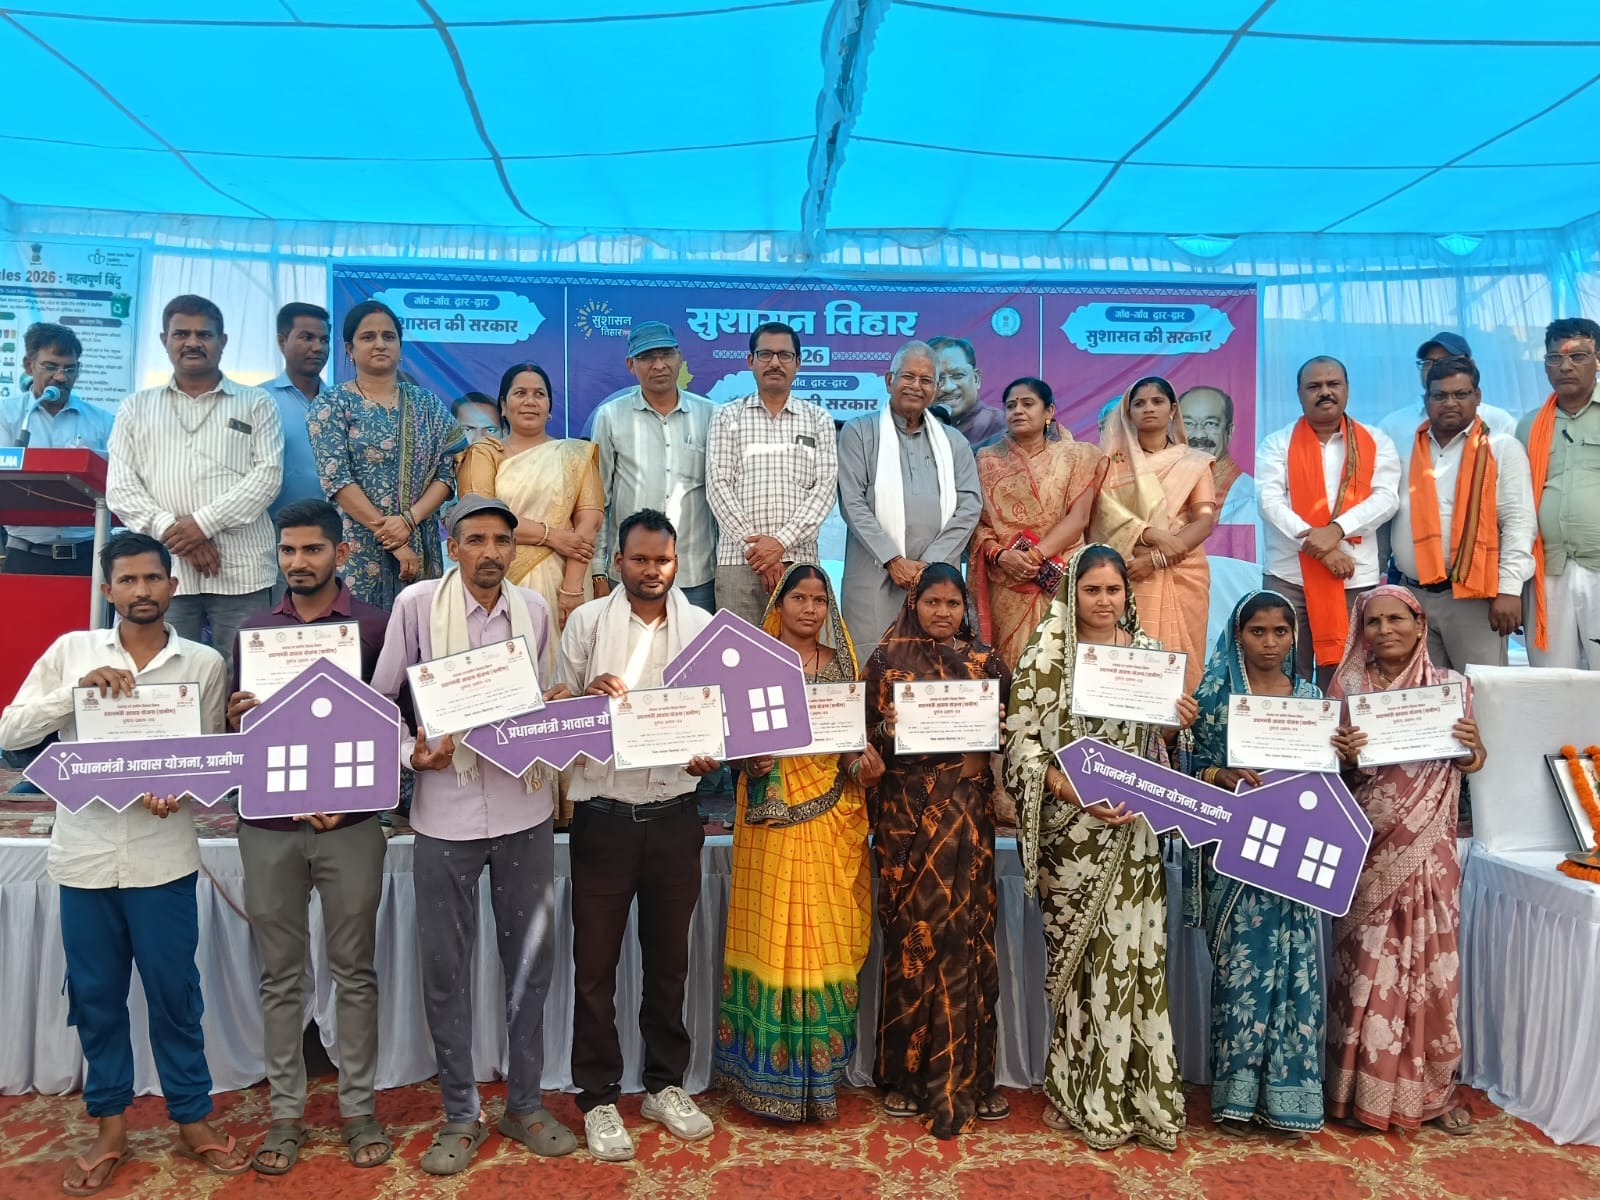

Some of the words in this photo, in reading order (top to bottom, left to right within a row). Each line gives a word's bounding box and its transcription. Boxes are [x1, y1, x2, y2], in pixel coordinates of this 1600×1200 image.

[26, 270, 56, 284] 2026
[66, 272, 102, 288] महत्वपूर्ण
[104, 272, 122, 289] बिंदु
[399, 317, 441, 331] शासन
[444, 313, 465, 332] की
[469, 319, 518, 333] सरकार
[592, 316, 632, 328] सुशासन
[824, 300, 918, 336] तिहार
[601, 326, 622, 336] तिहार
[1086, 329, 1140, 347] सुशासन
[1144, 326, 1163, 344] की
[1167, 330, 1212, 344] सरकार
[802, 349, 824, 364] 26
[826, 399, 878, 410] सरकार
[506, 718, 560, 739] प्रधानमंत्री
[562, 716, 595, 731] आवास
[70, 758, 124, 776] प्रधानमंत्री
[127, 758, 162, 772] आवास
[164, 754, 204, 770] योजना,
[206, 751, 244, 767] ग्रामीण
[1092, 761, 1137, 786] प्रधानमंत्री
[1136, 778, 1166, 798] आवास
[1166, 788, 1198, 812] योजना,
[1200, 802, 1232, 823] ग्रामीण
